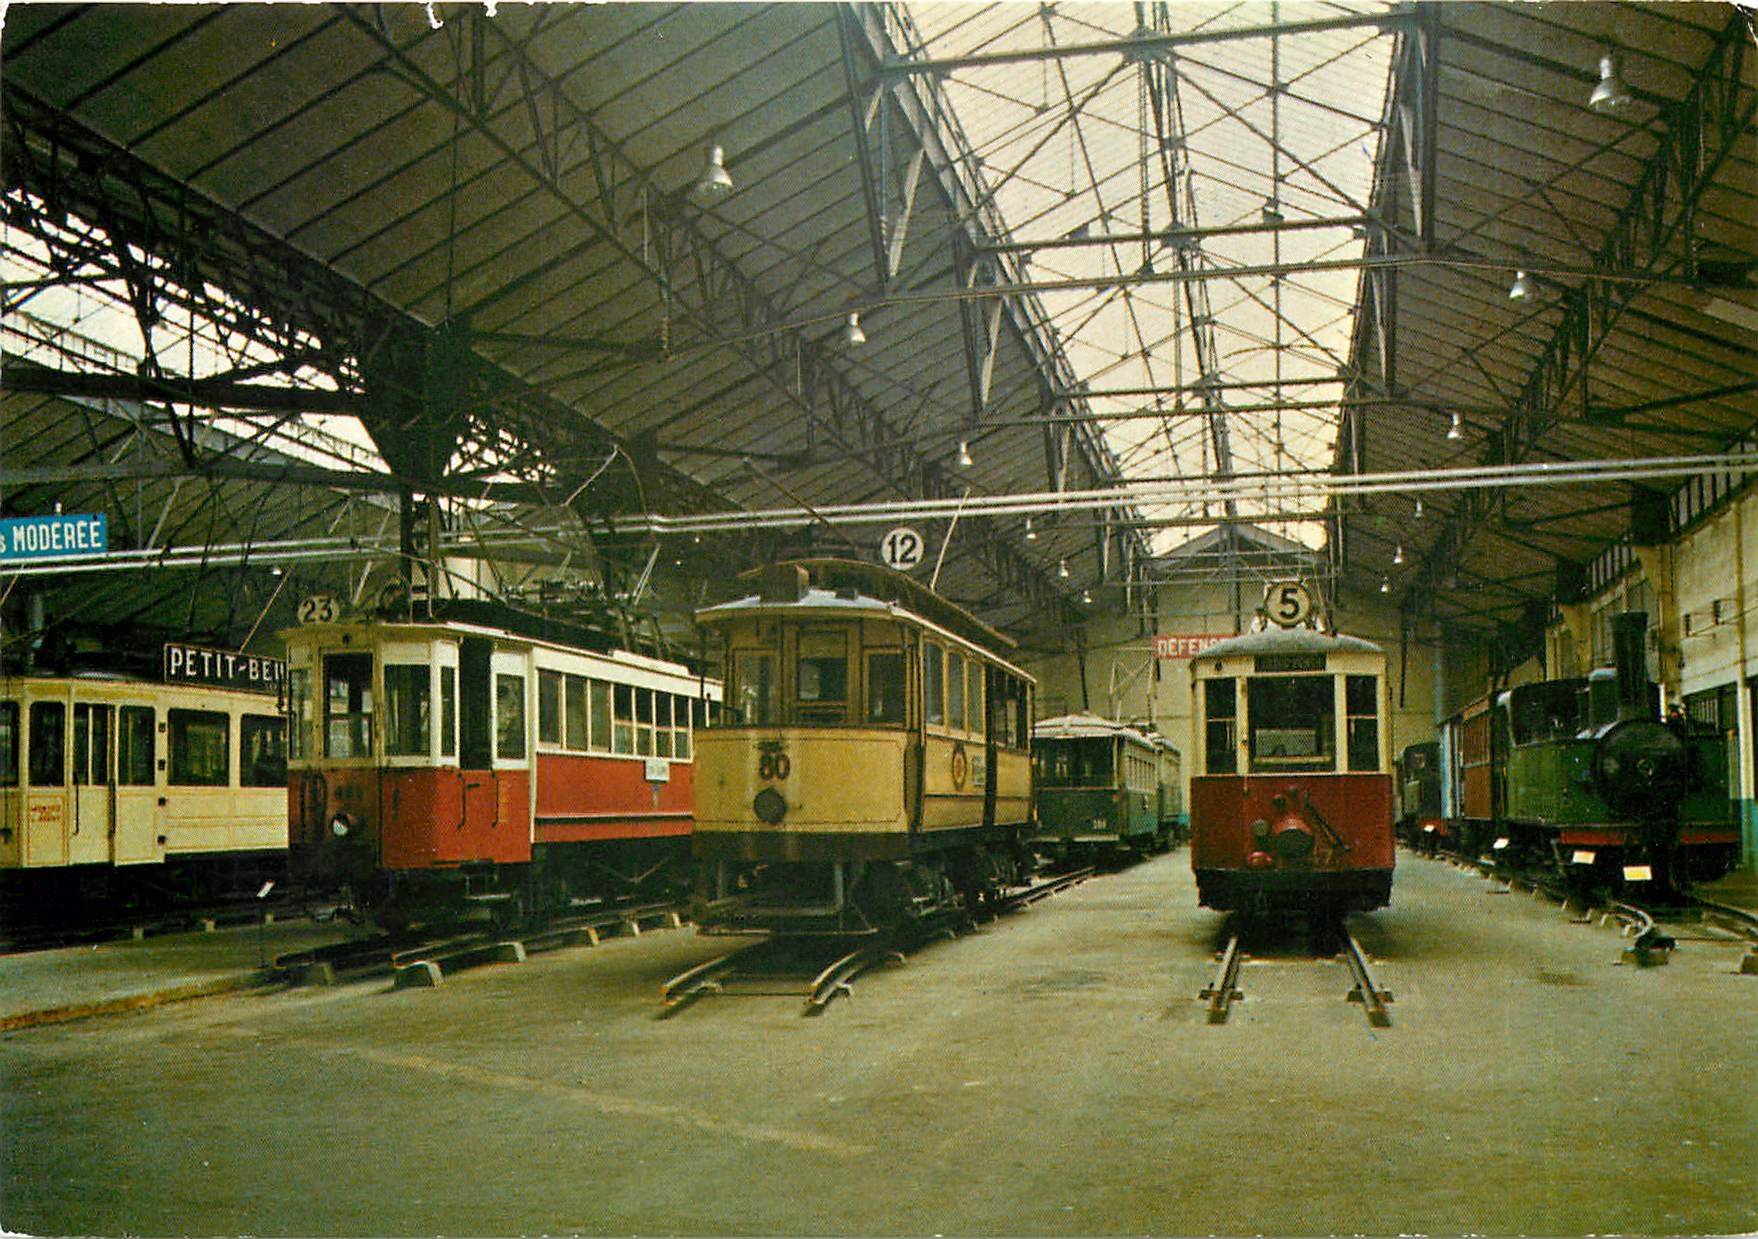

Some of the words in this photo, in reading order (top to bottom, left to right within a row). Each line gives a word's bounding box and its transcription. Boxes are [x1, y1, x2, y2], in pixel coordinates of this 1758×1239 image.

[888, 534, 916, 563] 12
[302, 598, 333, 623] 23
[1280, 587, 1301, 620] 5
